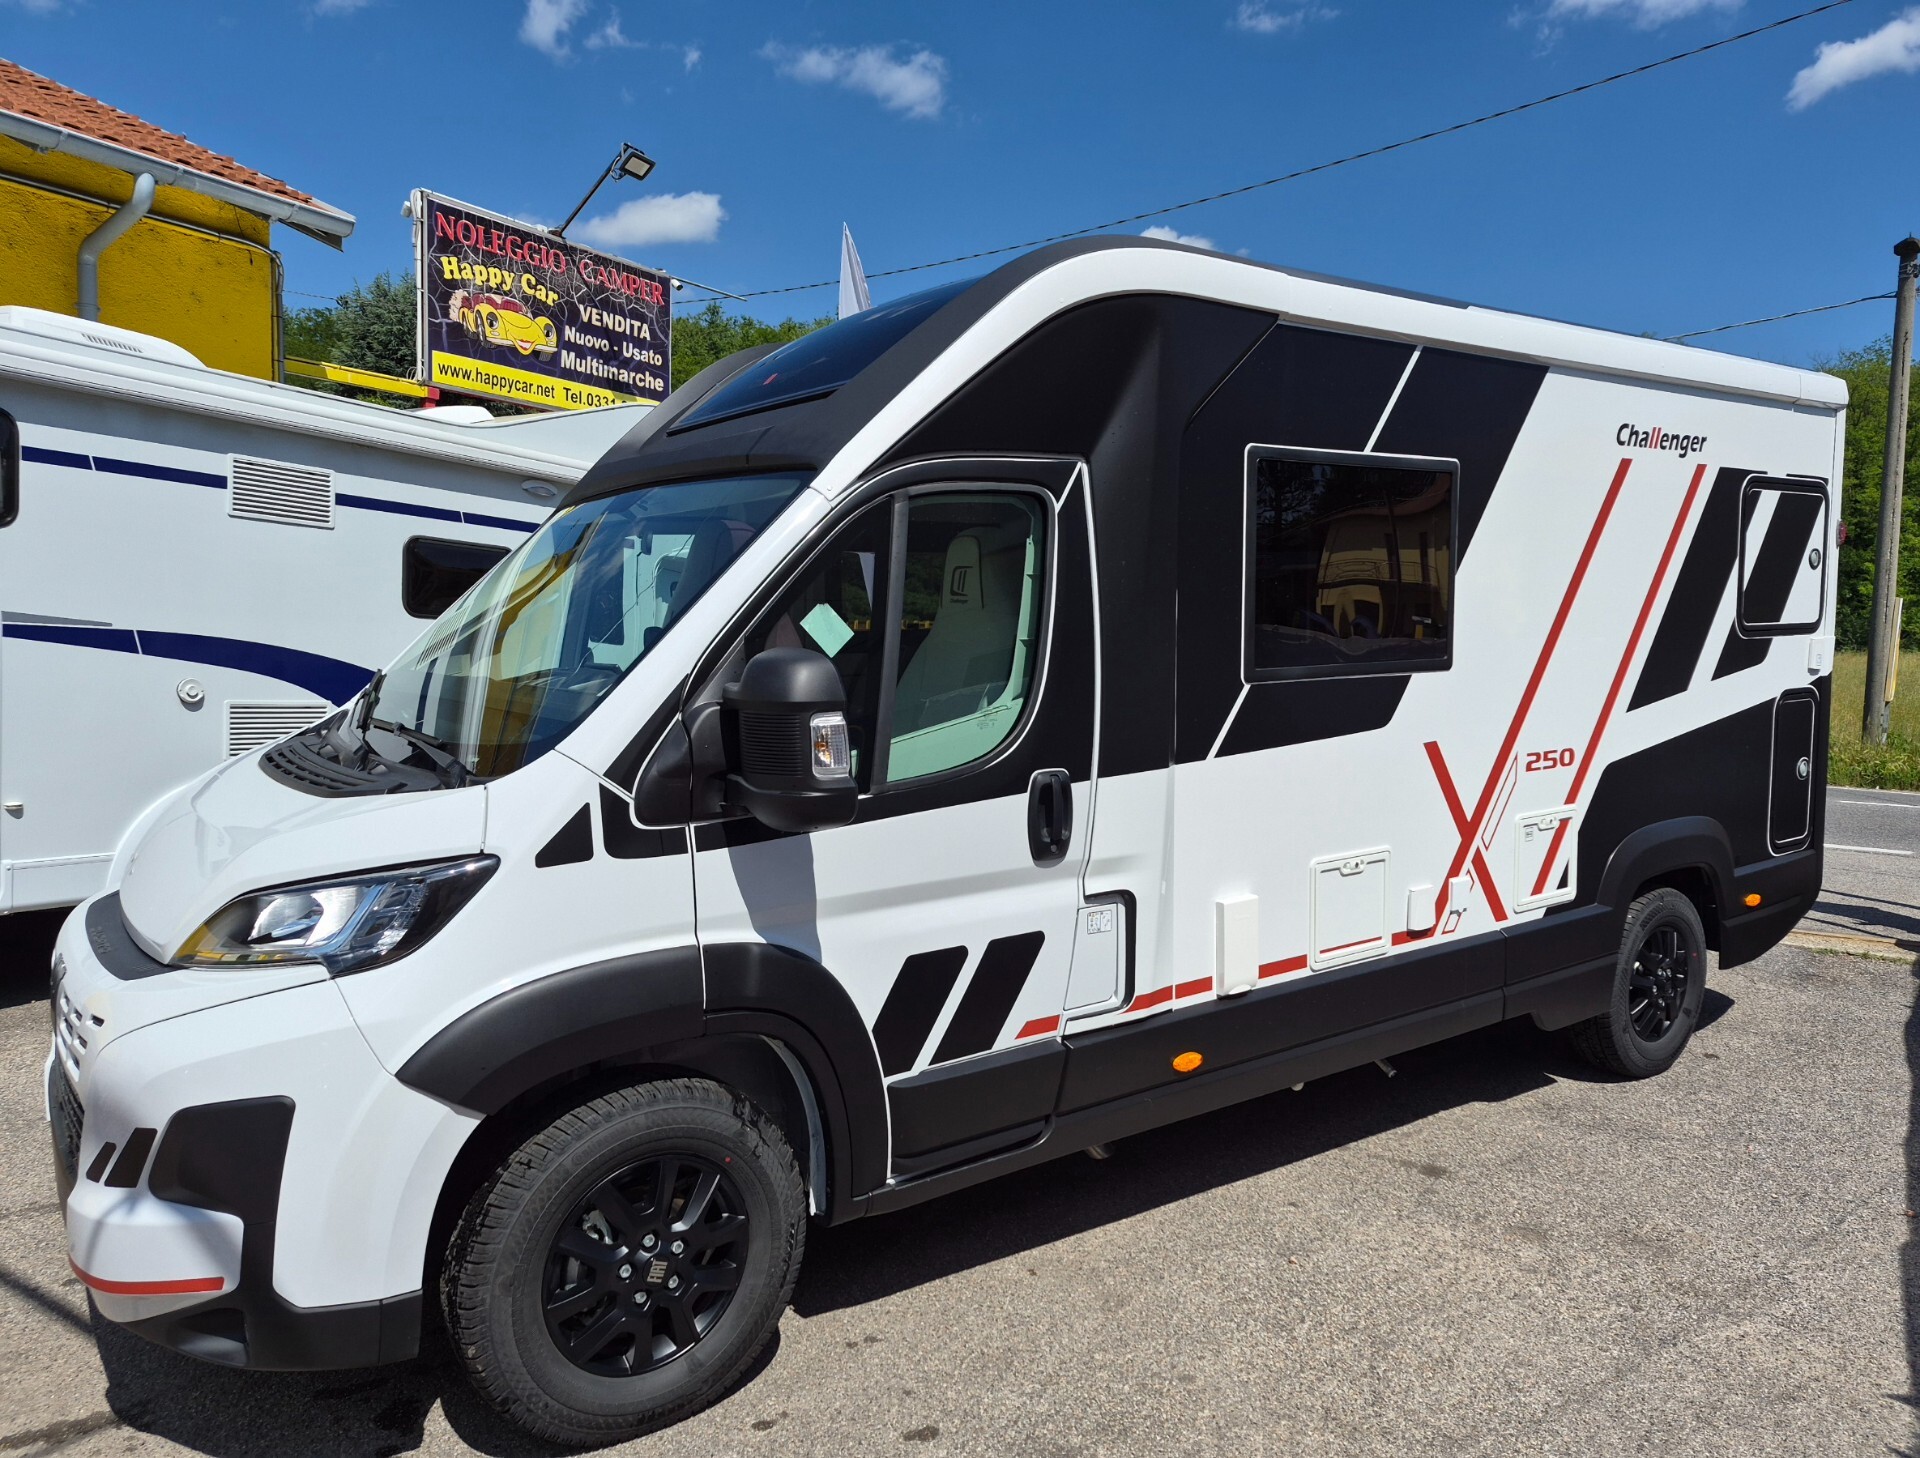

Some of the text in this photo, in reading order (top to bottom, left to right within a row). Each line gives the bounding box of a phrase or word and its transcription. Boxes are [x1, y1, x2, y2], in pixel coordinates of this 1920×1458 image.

[435, 211, 665, 306] NOLEGGIO CAMPER
[440, 256, 558, 306] Happy Car
[579, 304, 650, 341] VENDITA
[564, 325, 610, 352] Nuovo
[622, 341, 663, 366] Usato
[438, 363, 556, 399] www.happycar.net
[560, 349, 665, 392] Multimarche
[1616, 423, 1708, 459] Challenger
[1525, 747, 1576, 772] 250
[646, 1259, 669, 1283] FIAT
